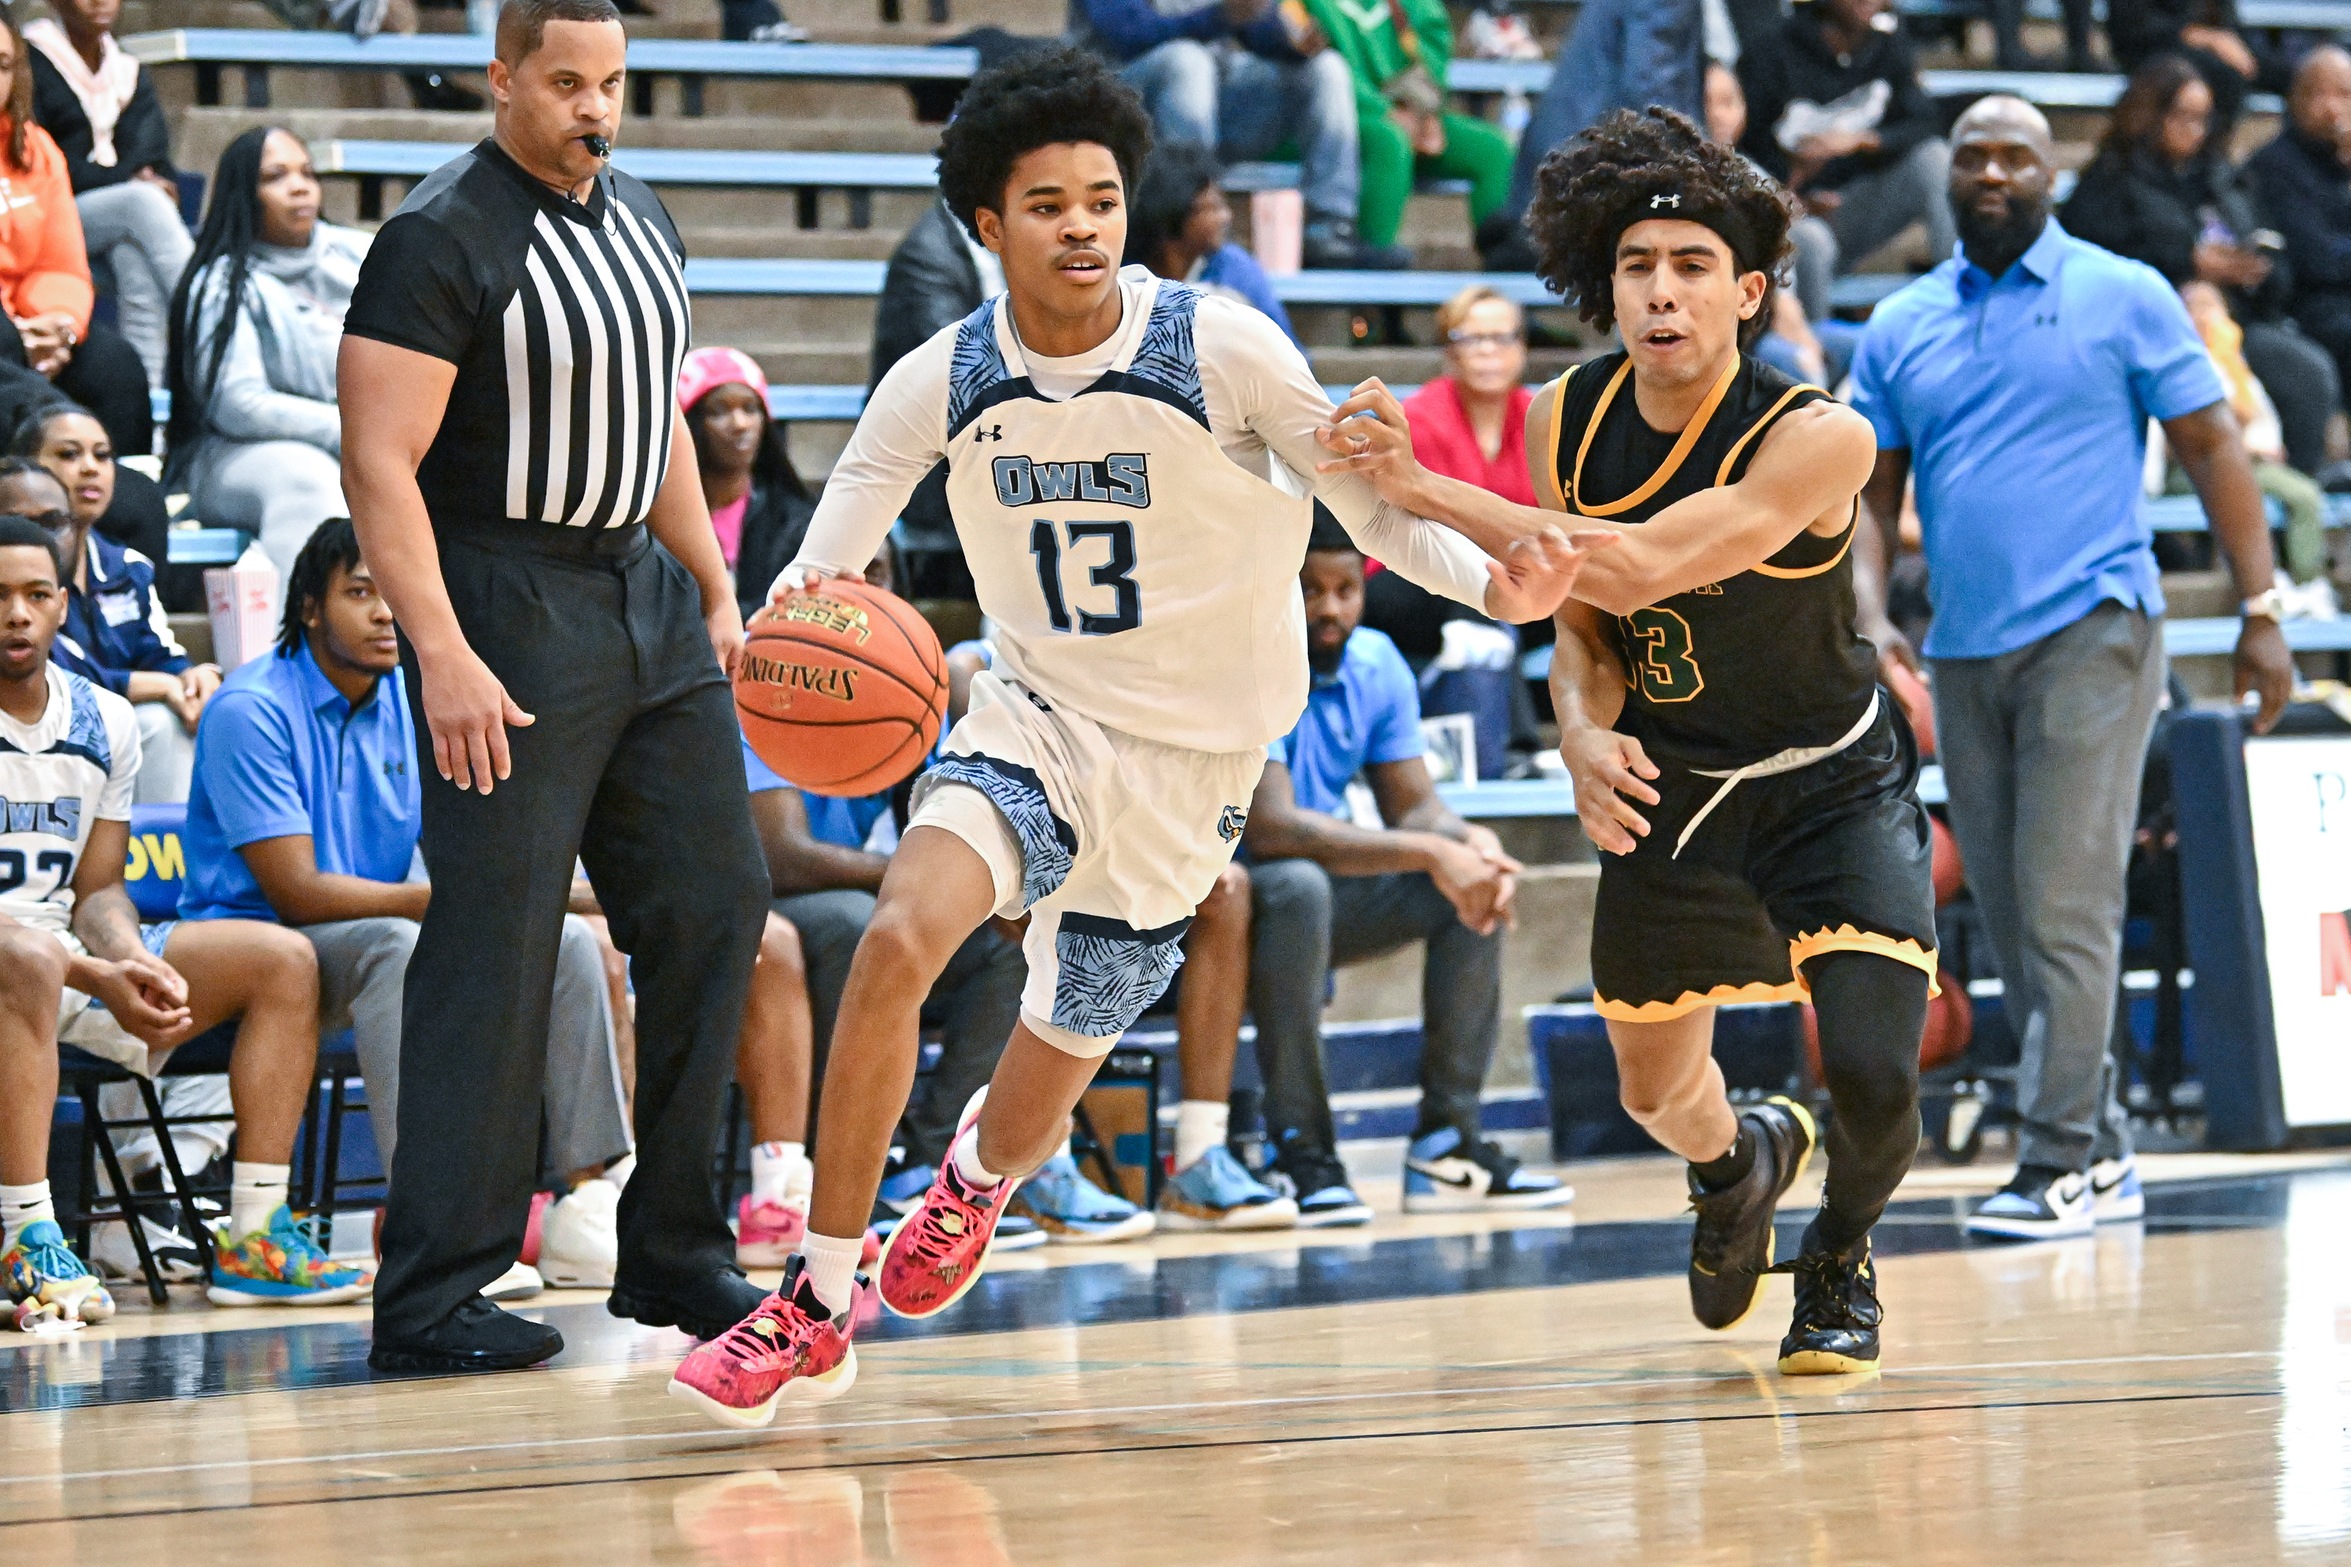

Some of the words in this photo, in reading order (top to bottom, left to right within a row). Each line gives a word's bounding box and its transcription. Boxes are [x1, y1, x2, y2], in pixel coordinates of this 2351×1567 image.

[991, 453, 1151, 508] OWLS
[1029, 519, 1142, 636] 13
[738, 651, 858, 703] SPALDING
[1618, 606, 1704, 703] 3
